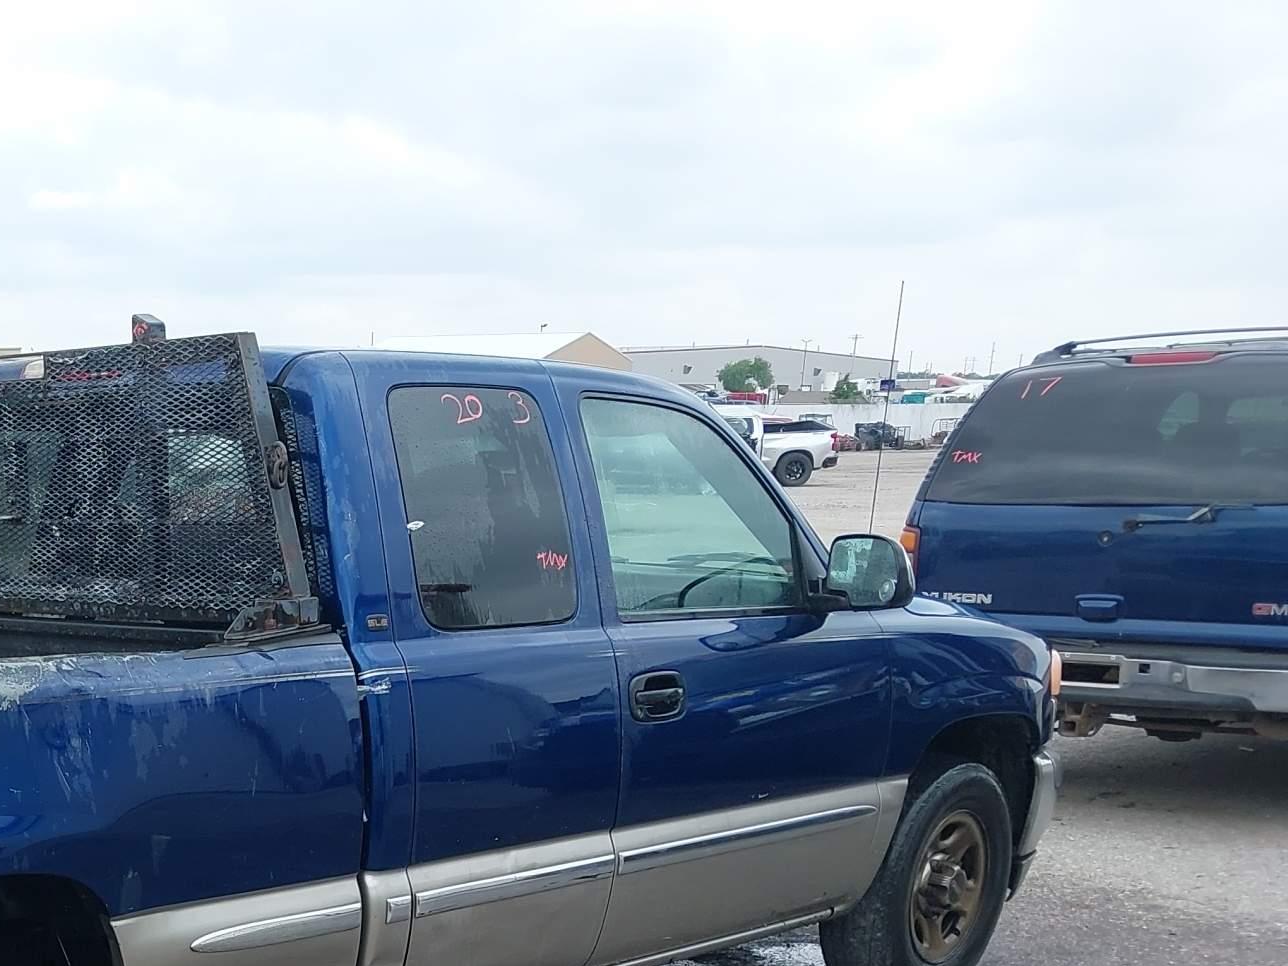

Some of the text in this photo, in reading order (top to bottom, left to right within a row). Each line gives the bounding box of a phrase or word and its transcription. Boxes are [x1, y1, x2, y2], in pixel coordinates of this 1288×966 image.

[1020, 376, 1063, 400] 17
[441, 391, 530, 424] 20 3
[921, 591, 992, 604] YUKON
